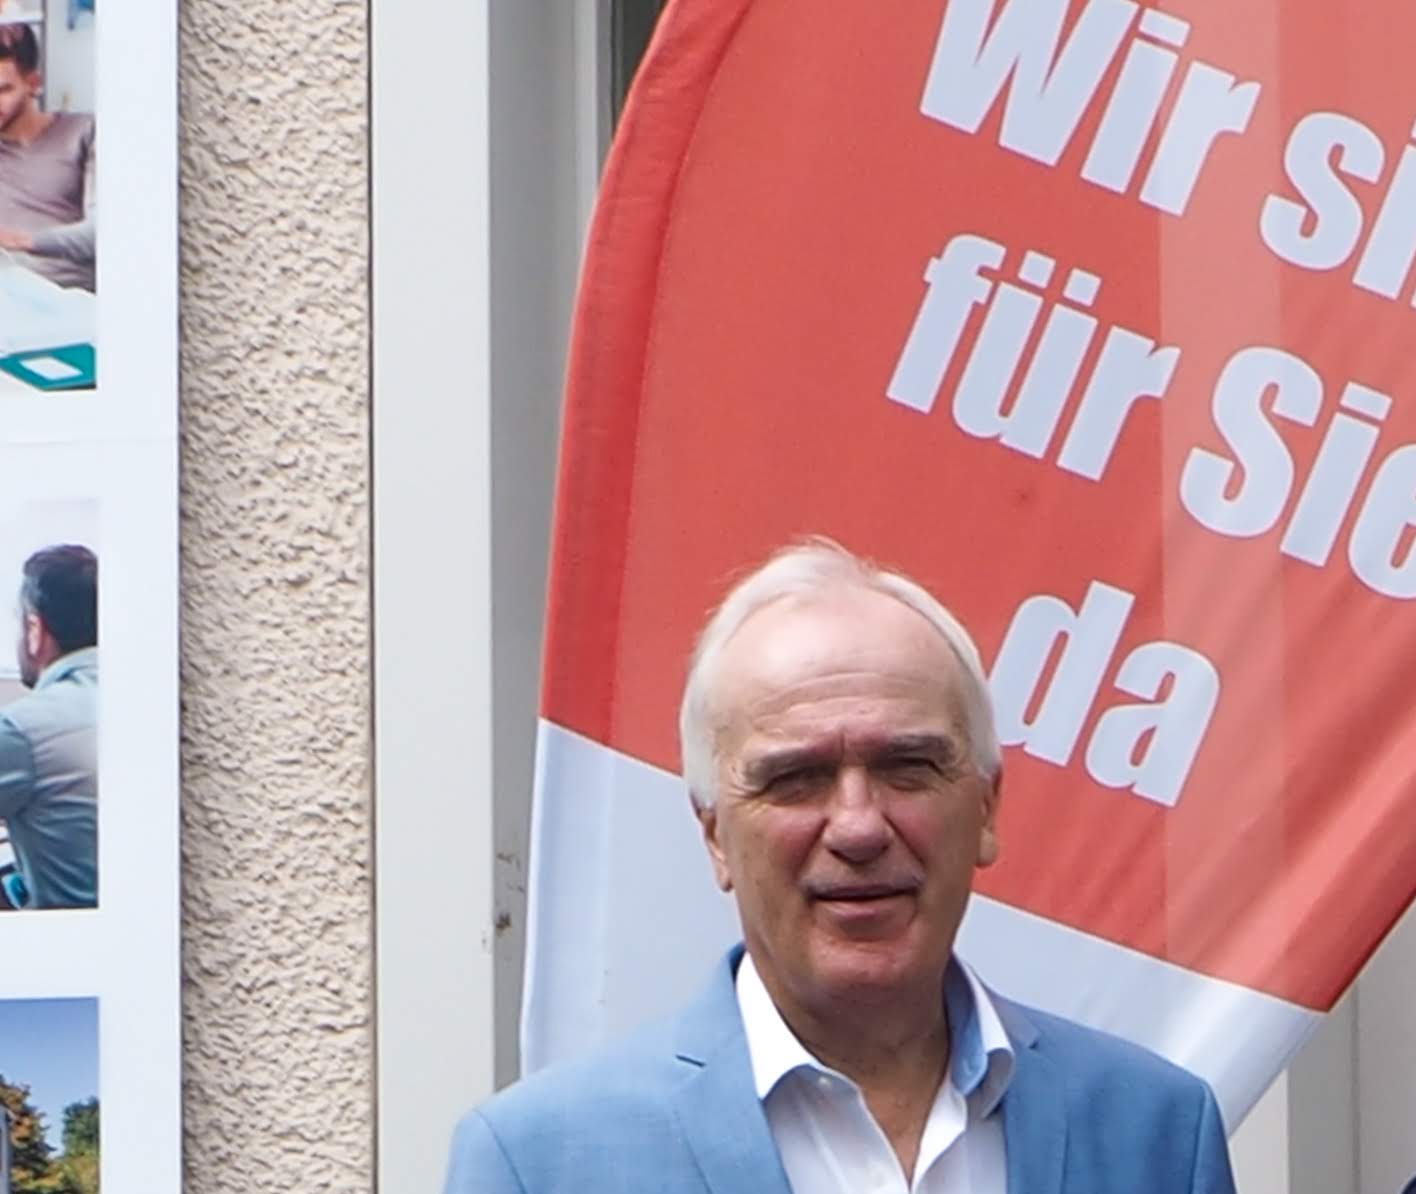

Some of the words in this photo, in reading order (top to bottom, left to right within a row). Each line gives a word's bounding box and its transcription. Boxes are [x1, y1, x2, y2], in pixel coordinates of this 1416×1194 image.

[920, 0, 1262, 217] Wir
[885, 233, 1181, 482] für
[987, 579, 1221, 808] da
